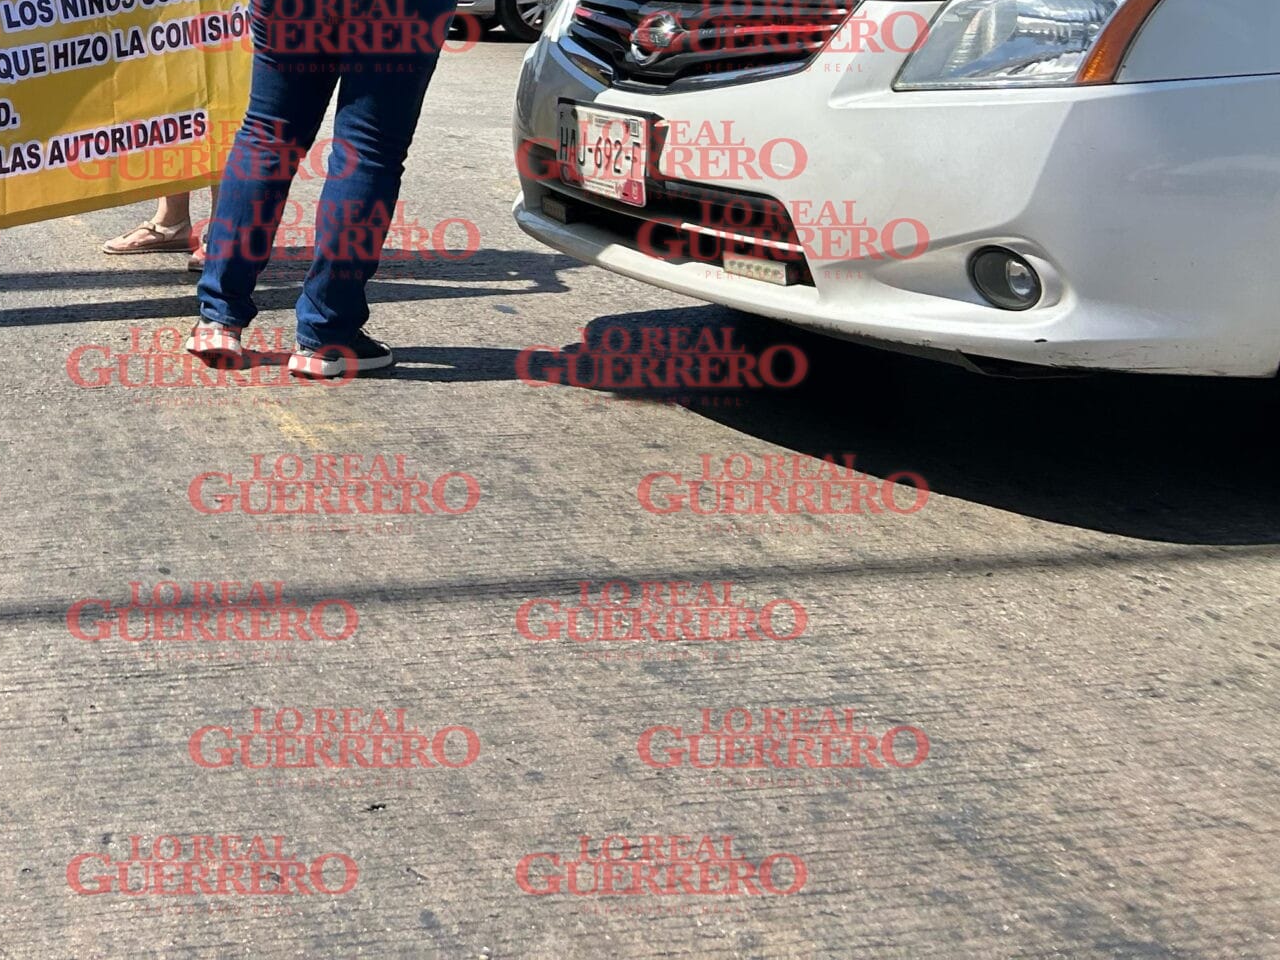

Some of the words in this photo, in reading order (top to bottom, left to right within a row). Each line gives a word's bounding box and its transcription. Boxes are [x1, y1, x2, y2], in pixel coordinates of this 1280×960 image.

[53, 36, 108, 69] HIZO
[115, 30, 144, 58] LA
[49, 113, 205, 165] AUTORIDADES
